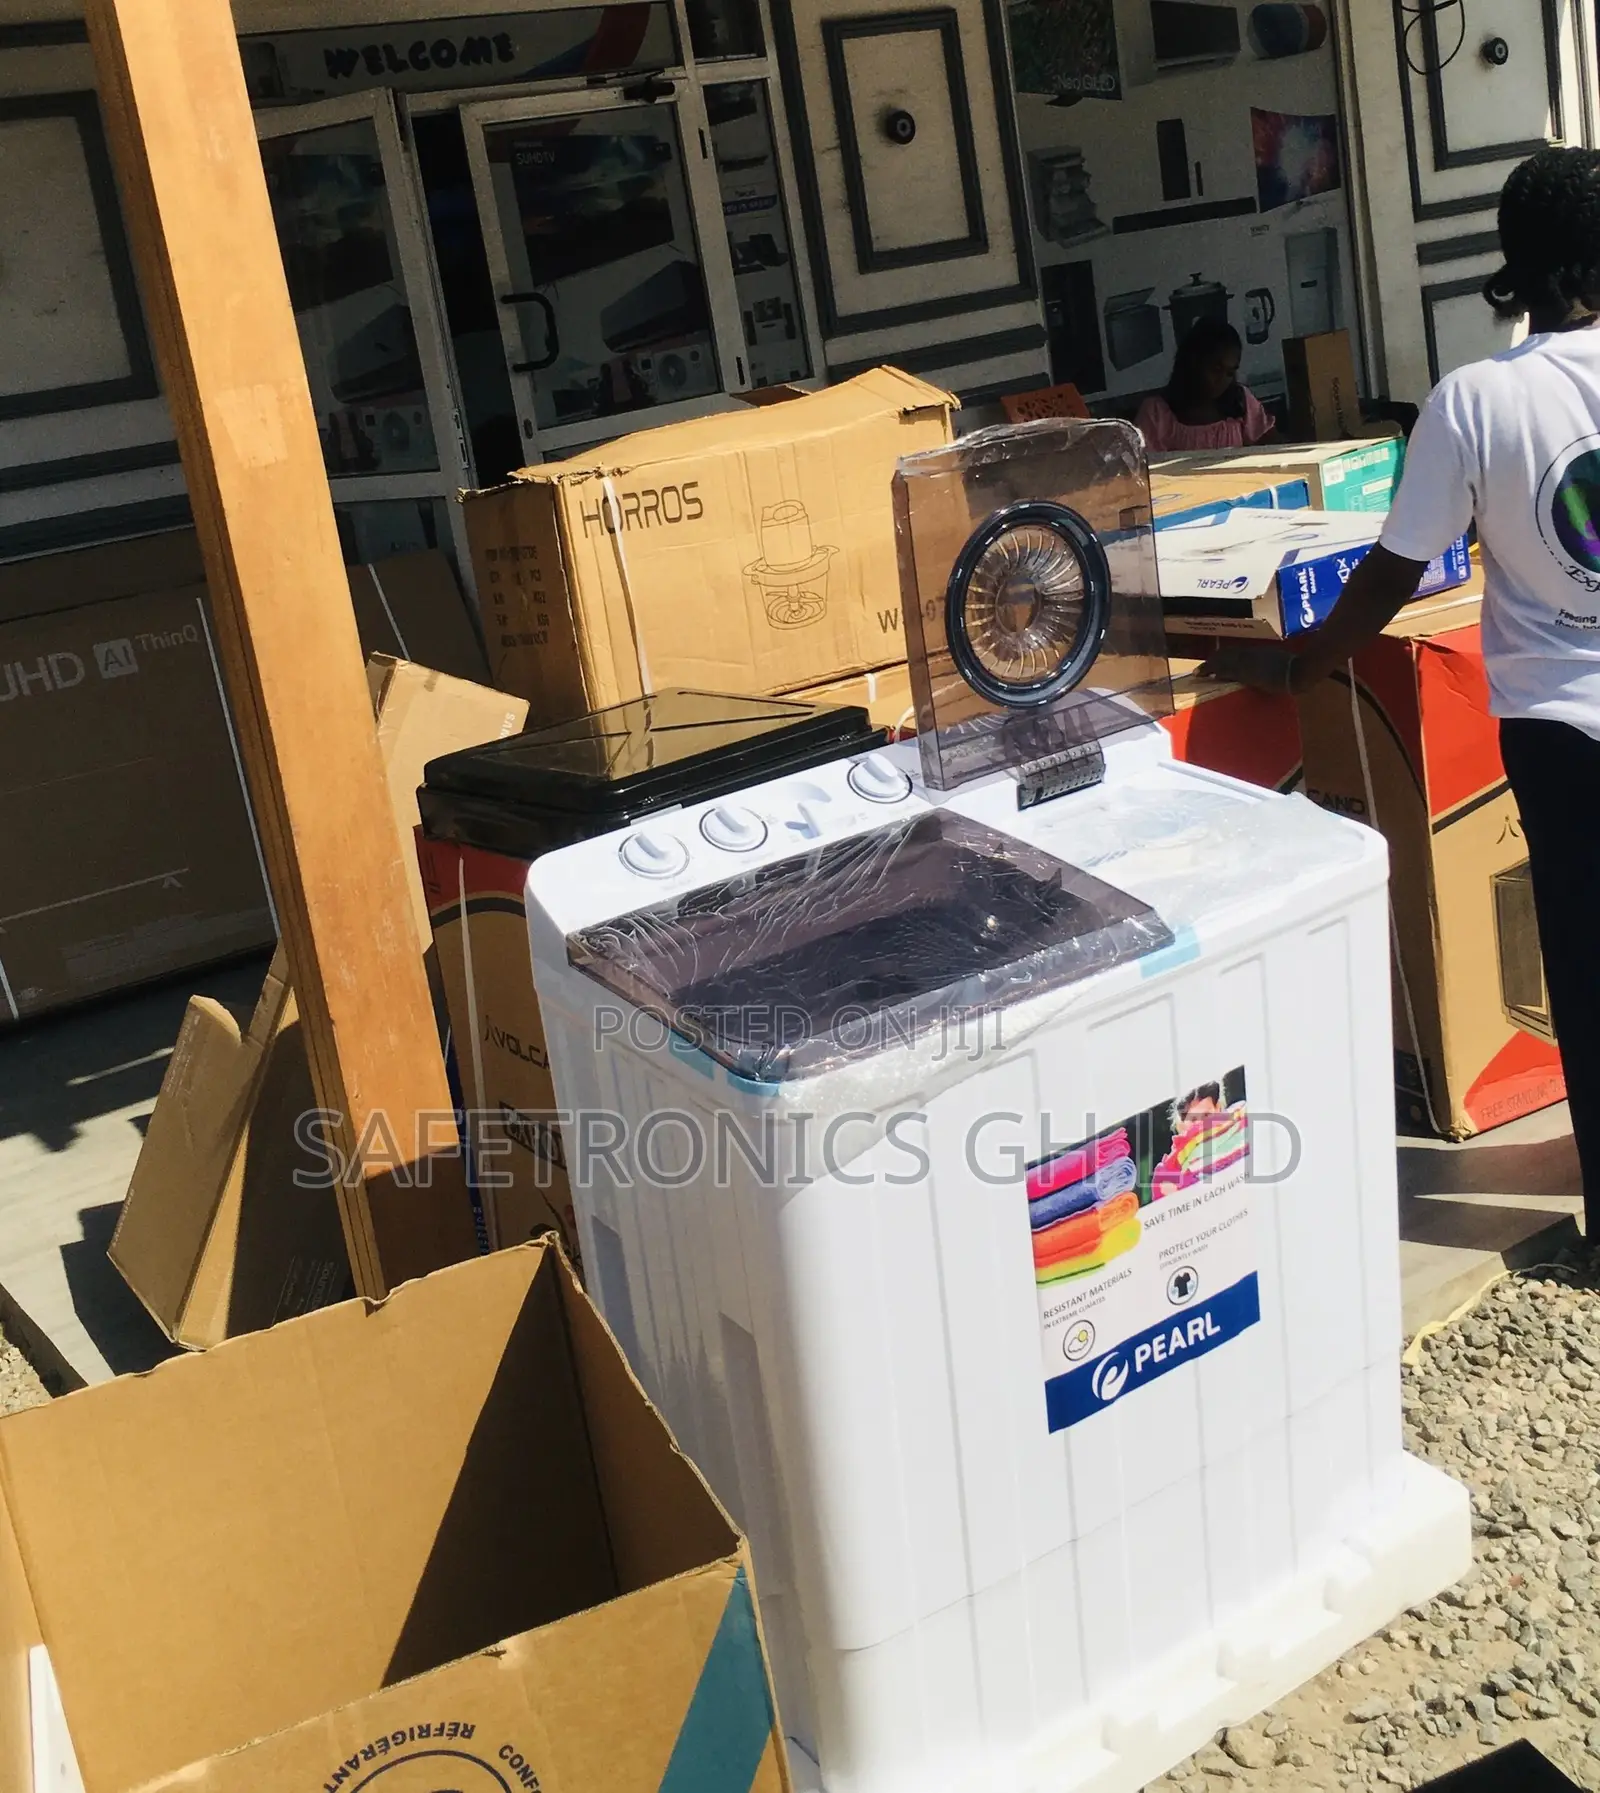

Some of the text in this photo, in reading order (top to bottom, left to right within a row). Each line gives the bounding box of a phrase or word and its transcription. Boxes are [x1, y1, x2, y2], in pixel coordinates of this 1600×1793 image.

[323, 32, 515, 79] WELCOME
[579, 481, 703, 539] HORROS
[1196, 578, 1231, 591] PEARL
[1298, 568, 1309, 609] PEARL
[135, 624, 200, 653] ThinQ
[1144, 1171, 1250, 1231] SAVE TIME IN EACH WASH
[1158, 1237, 1194, 1260] PROTECT
[1195, 1225, 1217, 1243] YOUR
[1043, 1267, 1133, 1320] RESISTANT MATERIALS
[1134, 1311, 1221, 1374] PEARL
[499, 1744, 541, 1793] CONF
